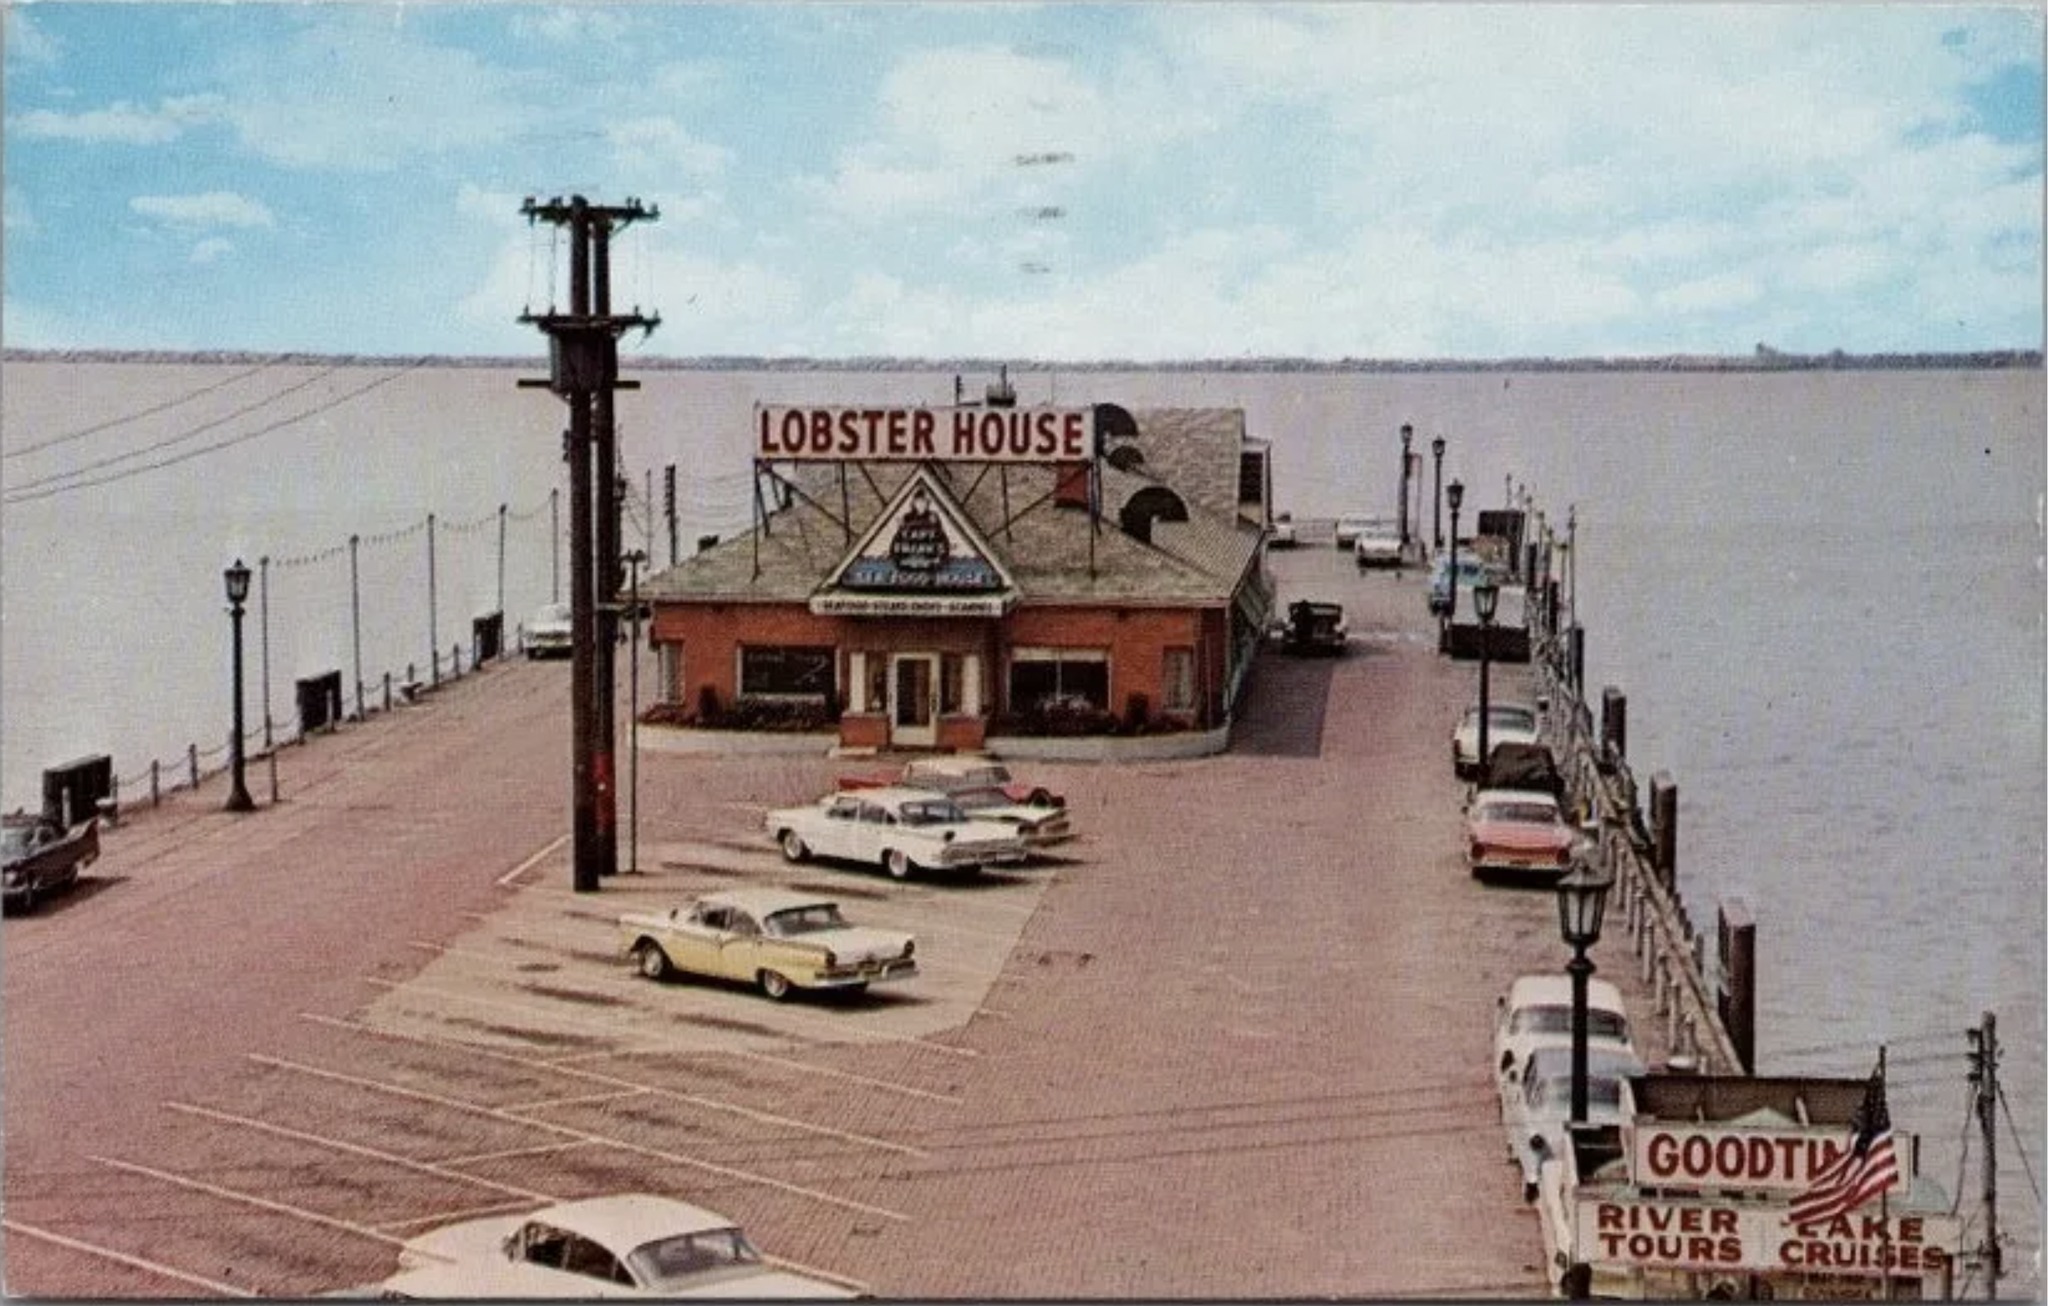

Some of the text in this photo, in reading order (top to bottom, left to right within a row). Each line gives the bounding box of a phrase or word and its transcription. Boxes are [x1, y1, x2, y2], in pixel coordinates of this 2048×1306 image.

[760, 409, 1084, 455] LOBSTER HOUSE
[1599, 1204, 1738, 1234] RIVER
[1600, 1234, 1742, 1262] TOURS
[1779, 1239, 1946, 1269] CRUISES
